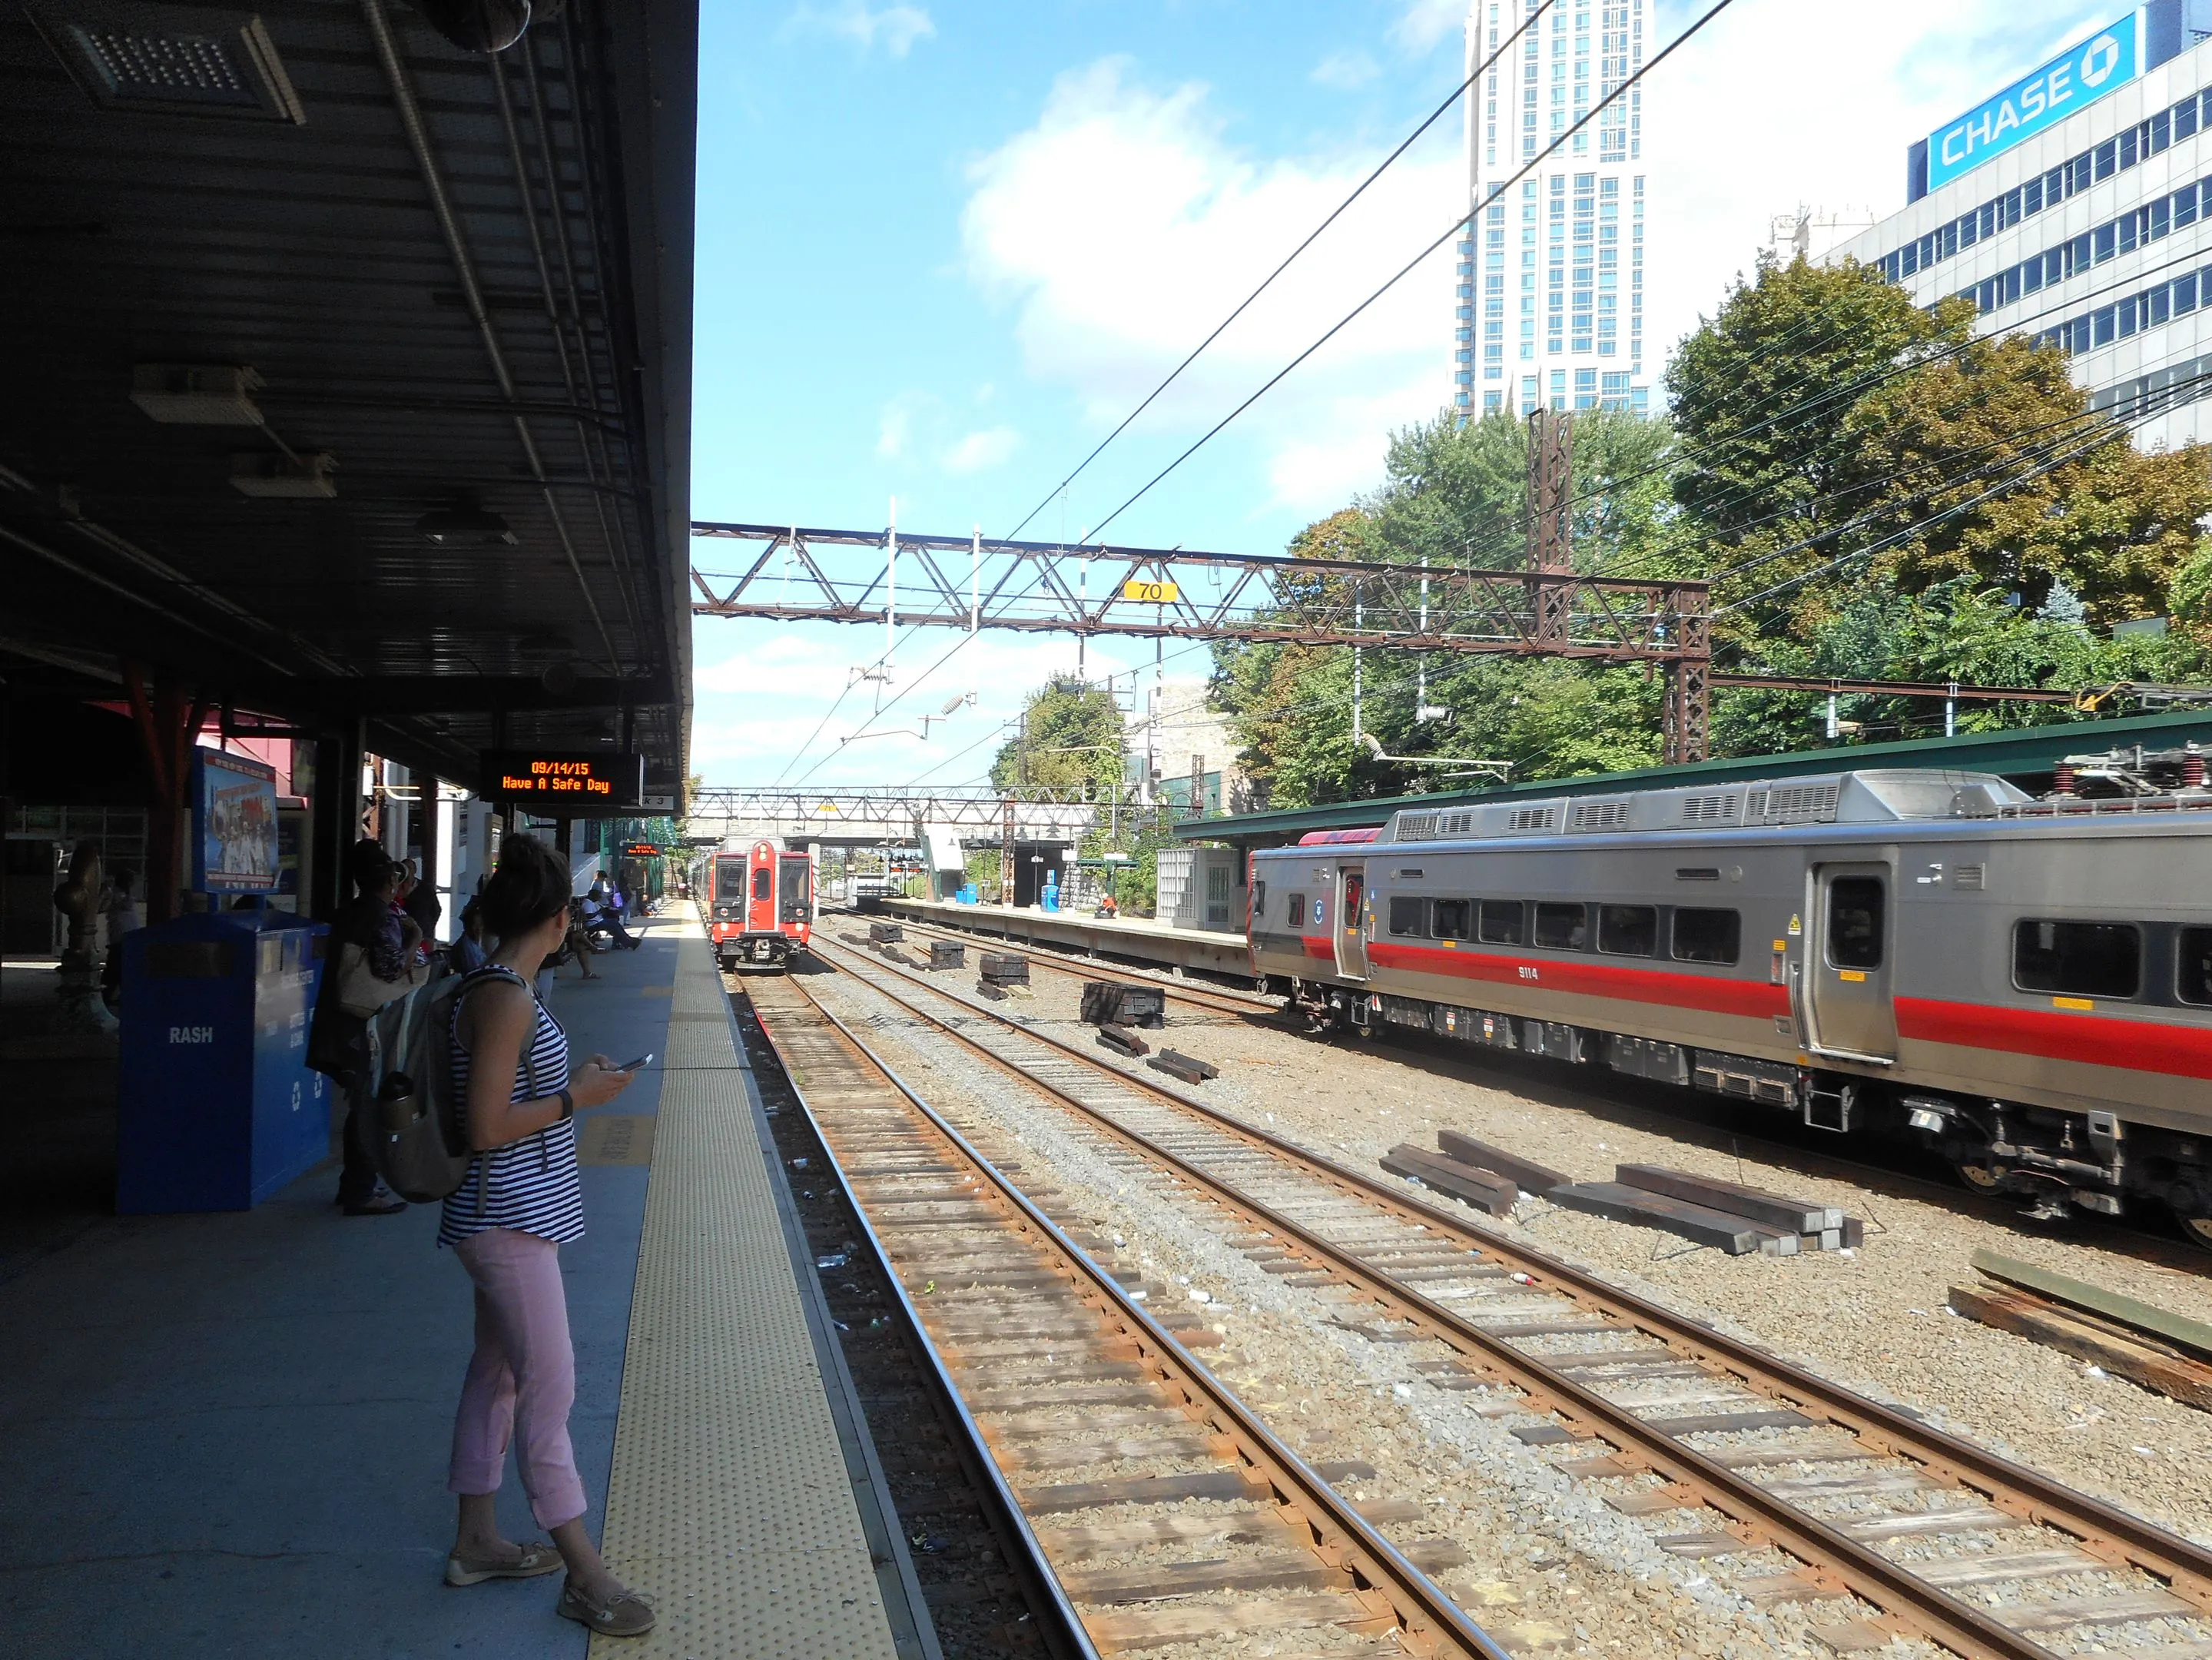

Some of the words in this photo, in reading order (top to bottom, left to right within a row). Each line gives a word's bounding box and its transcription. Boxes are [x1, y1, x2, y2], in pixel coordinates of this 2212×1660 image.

[1942, 61, 2074, 167] CHASE
[1139, 583, 1162, 599] 70
[532, 762, 589, 775] 09/14/15
[502, 776, 532, 789] Have
[538, 777, 546, 789] A
[552, 778, 581, 791] Safe
[587, 779, 609, 794] Day
[1517, 966, 1539, 981] 9114
[169, 1026, 213, 1044] RASH
